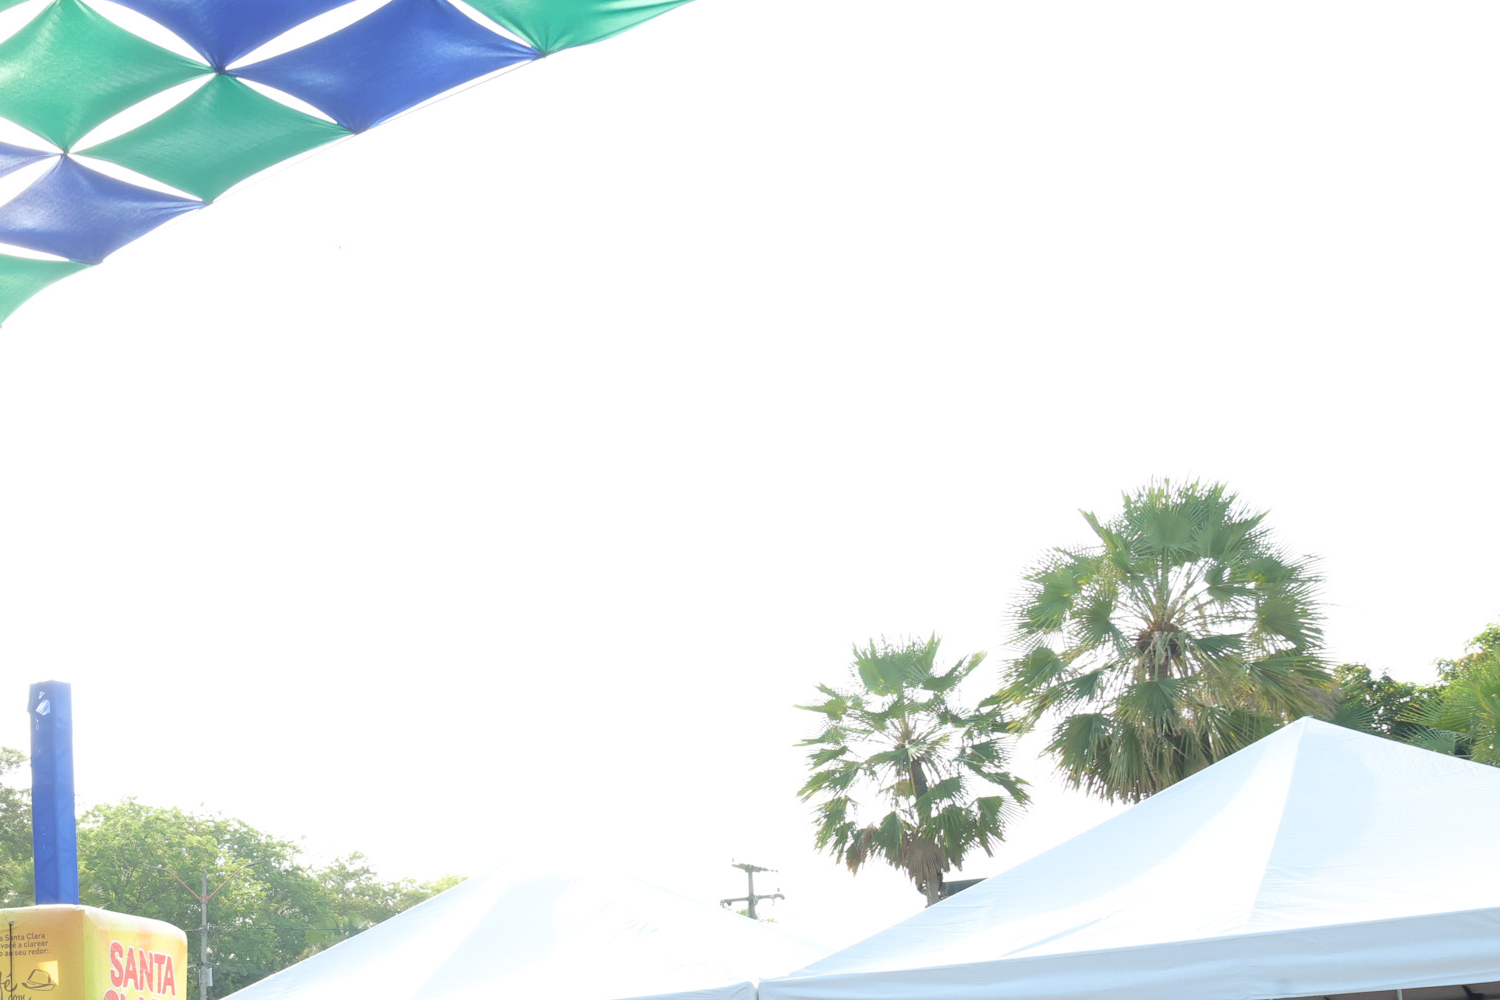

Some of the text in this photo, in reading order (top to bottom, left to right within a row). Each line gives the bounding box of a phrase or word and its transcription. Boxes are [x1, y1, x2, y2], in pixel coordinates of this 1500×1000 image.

[0, 941, 17, 949] você
[24, 940, 48, 948] clarear
[28, 948, 50, 956] redor:
[110, 940, 176, 997] SANTA
